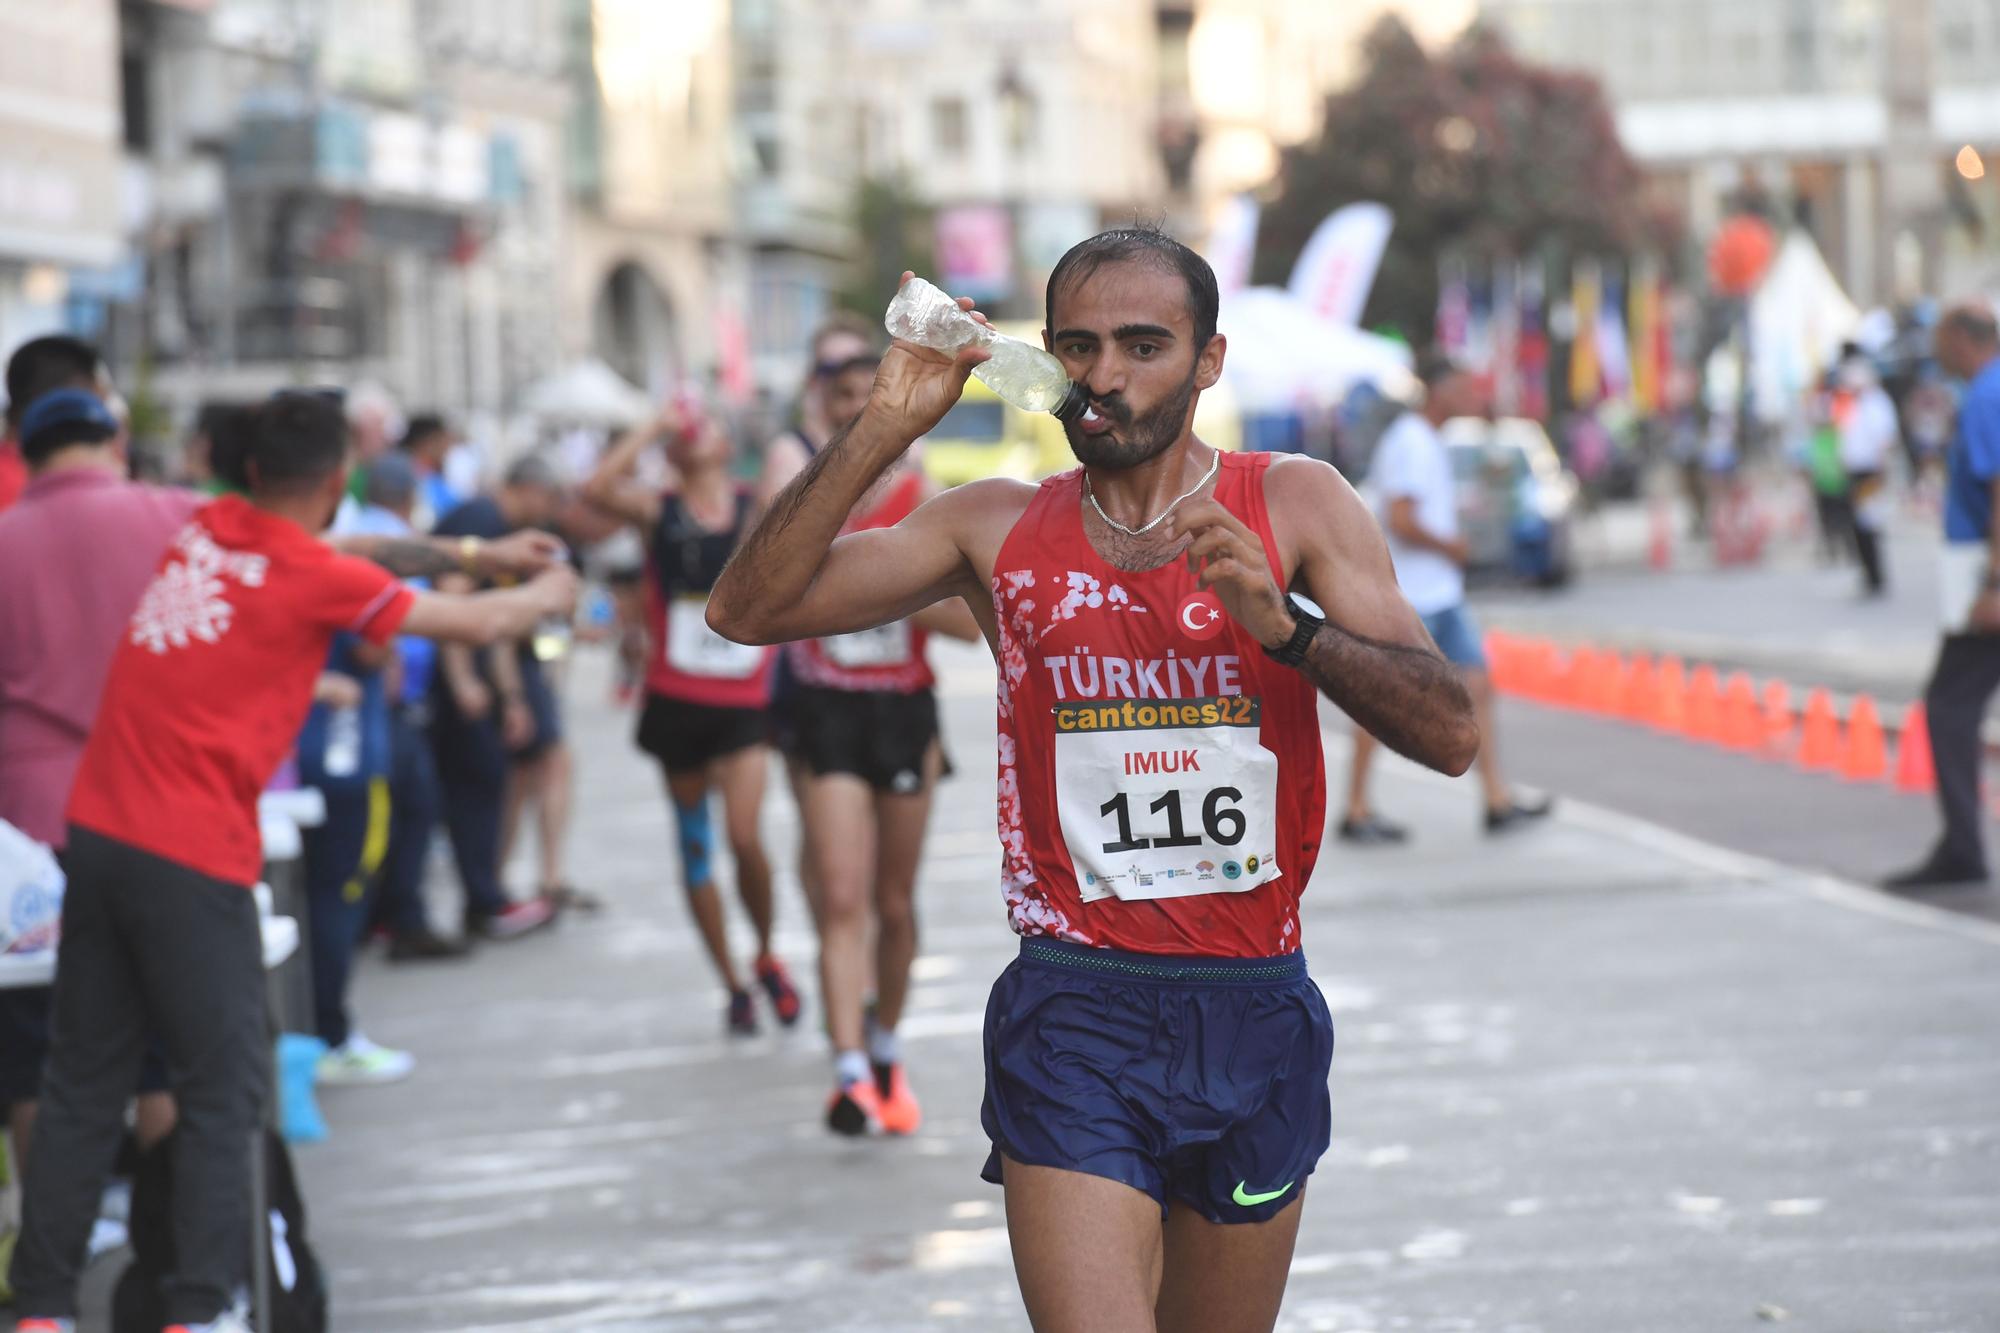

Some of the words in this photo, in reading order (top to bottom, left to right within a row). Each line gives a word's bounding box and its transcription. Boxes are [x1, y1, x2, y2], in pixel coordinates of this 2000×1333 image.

[1044, 646, 1241, 699] TÜRKİYE
[1057, 697, 1251, 730] cantones22
[1124, 750, 1200, 775] IMUK
[1100, 786, 1246, 853] 116
